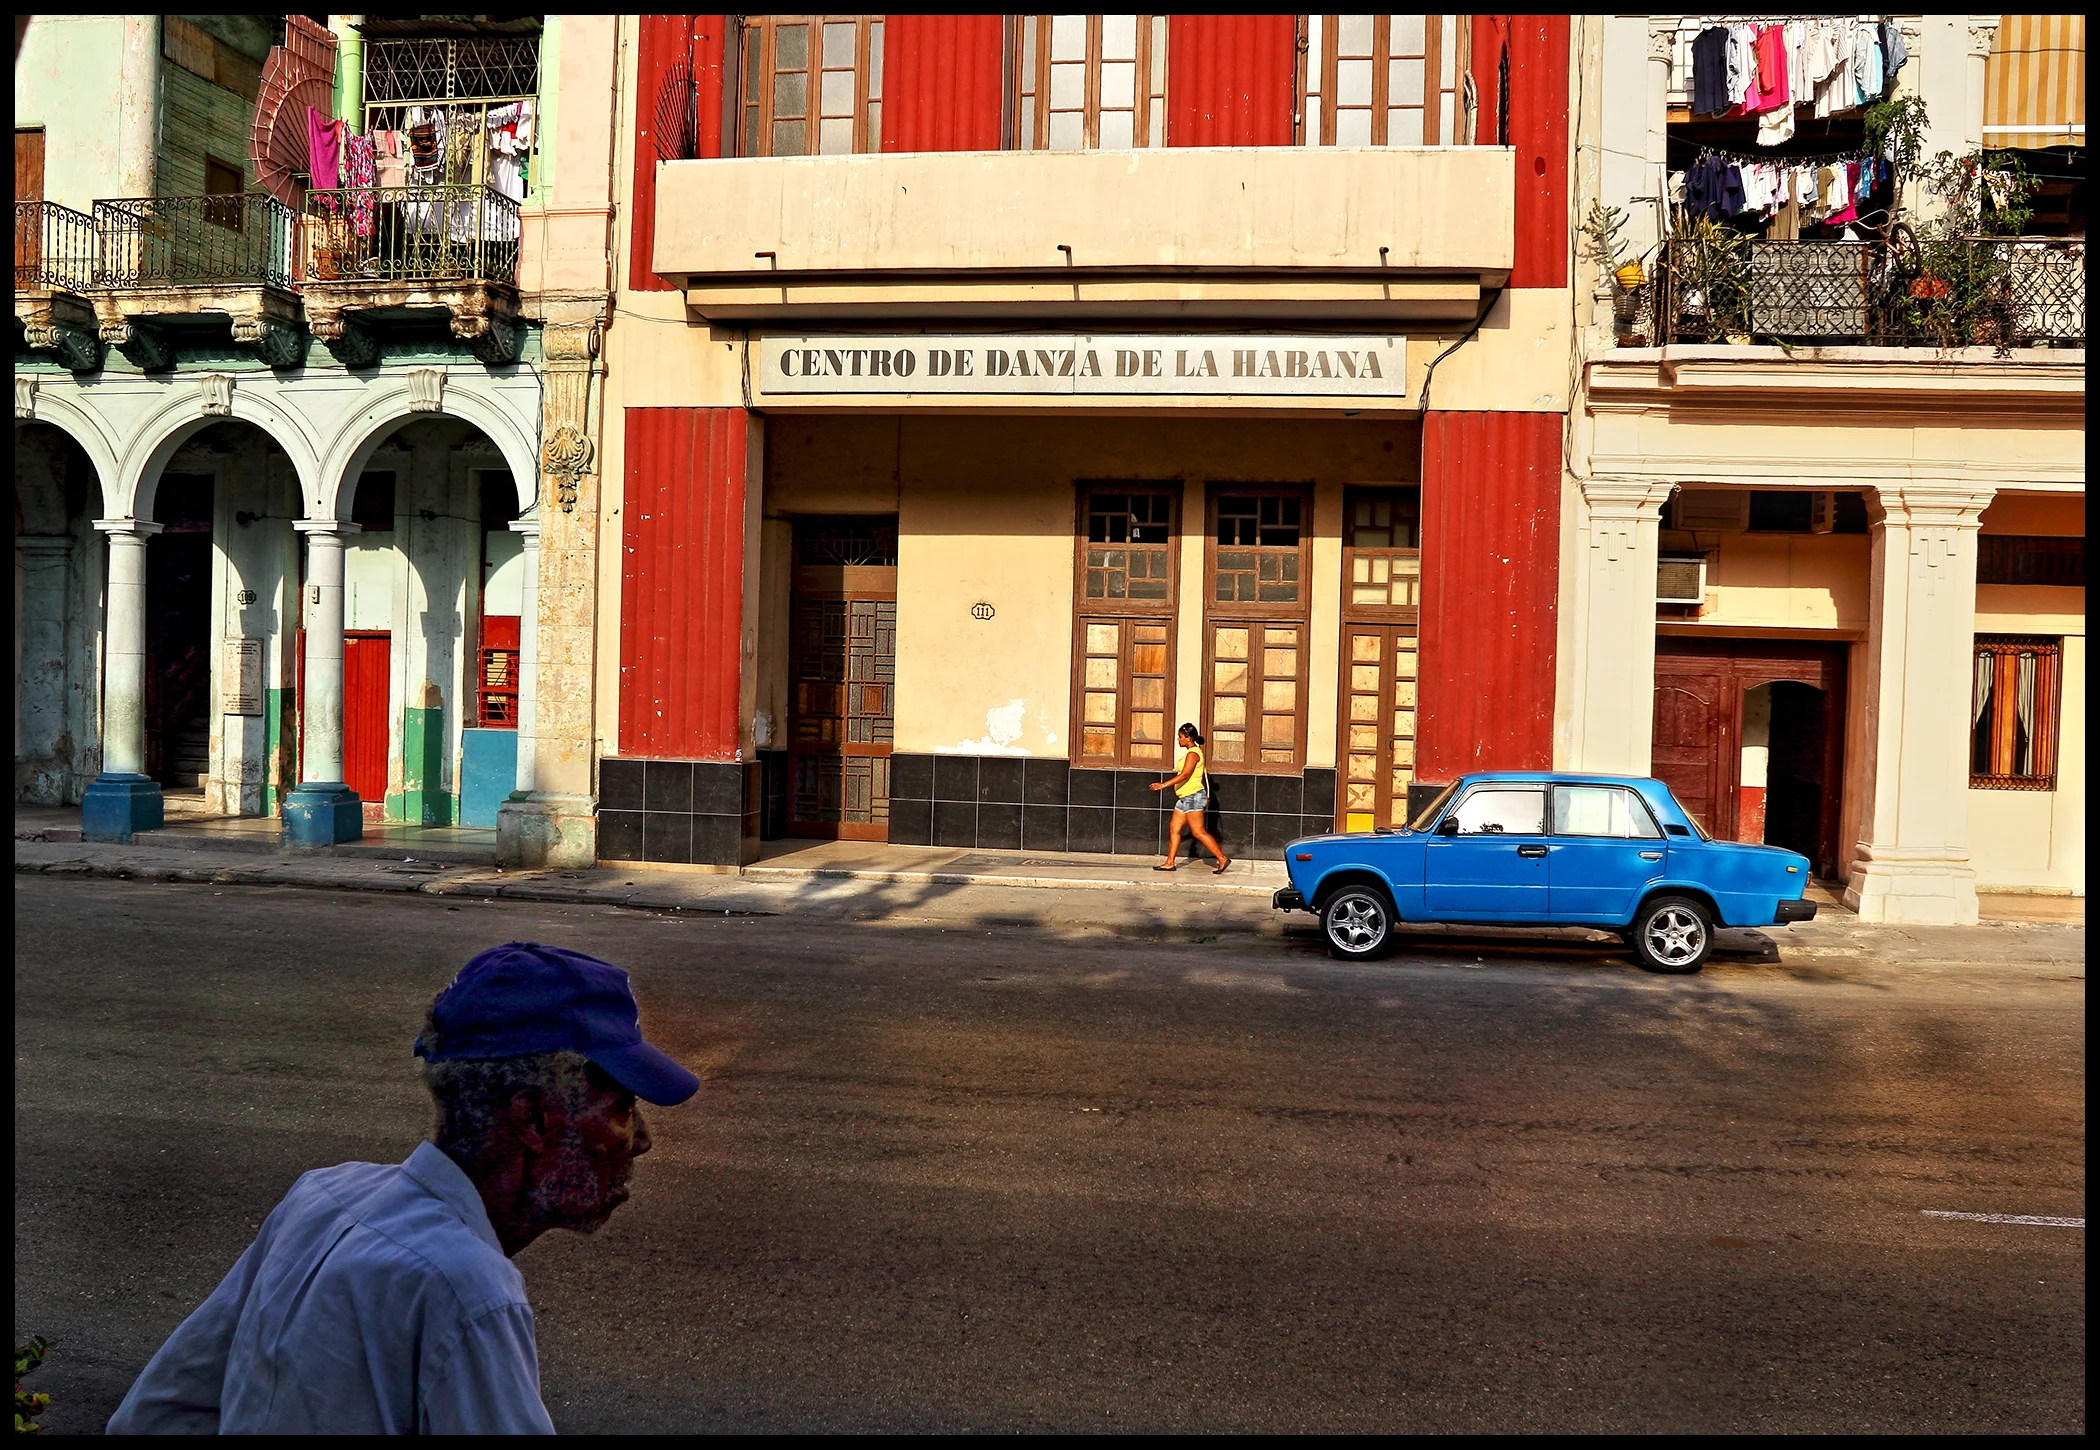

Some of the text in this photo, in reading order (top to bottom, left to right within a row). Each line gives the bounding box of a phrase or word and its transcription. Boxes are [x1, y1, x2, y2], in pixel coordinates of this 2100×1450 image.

[780, 349, 1383, 378] CENTRO DE DANZA DE LA HABANA
